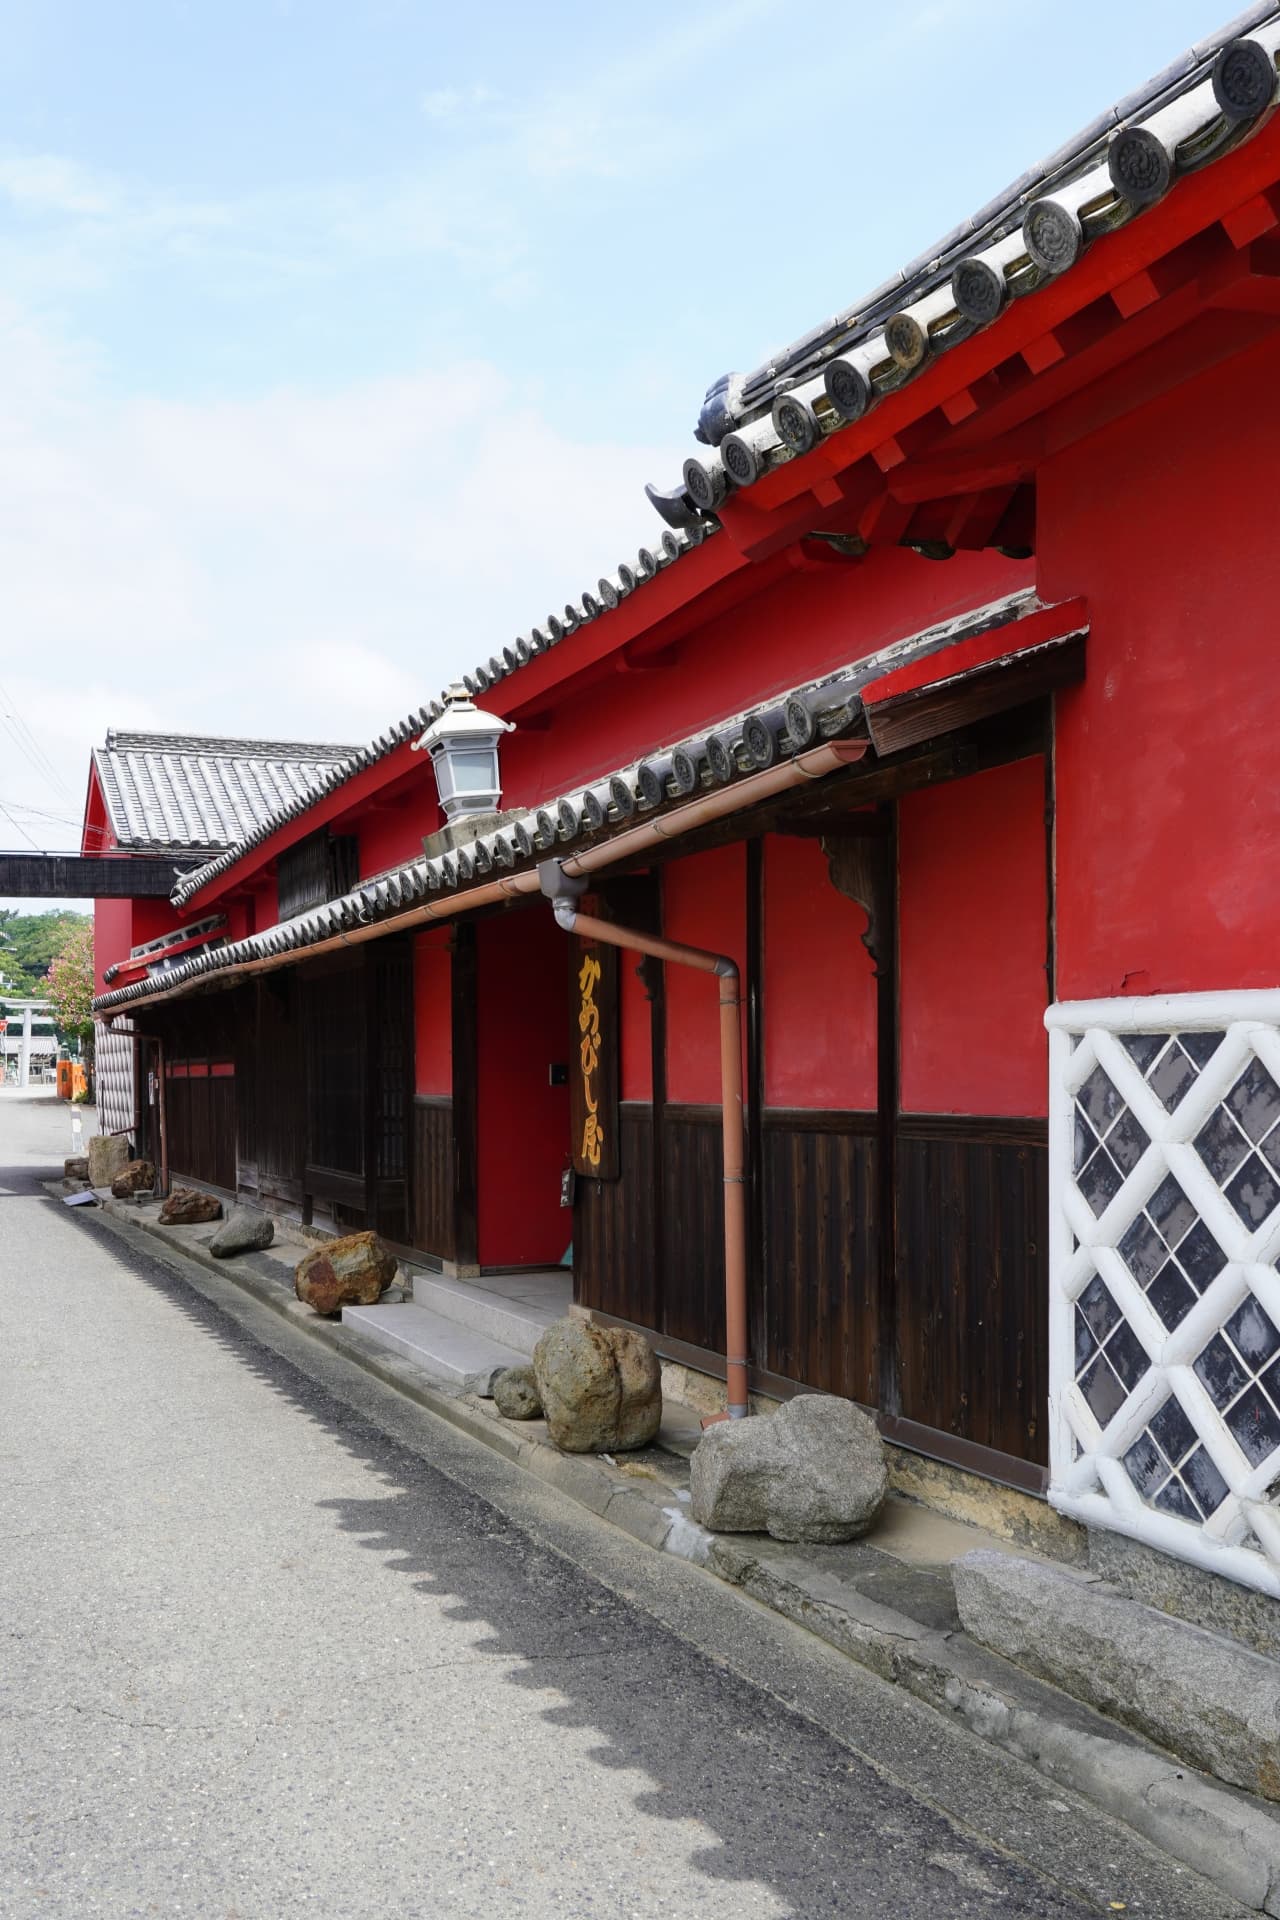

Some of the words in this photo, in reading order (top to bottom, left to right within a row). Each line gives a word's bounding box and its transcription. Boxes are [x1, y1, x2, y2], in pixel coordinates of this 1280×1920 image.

[578, 955, 603, 1165] かめびし屋
